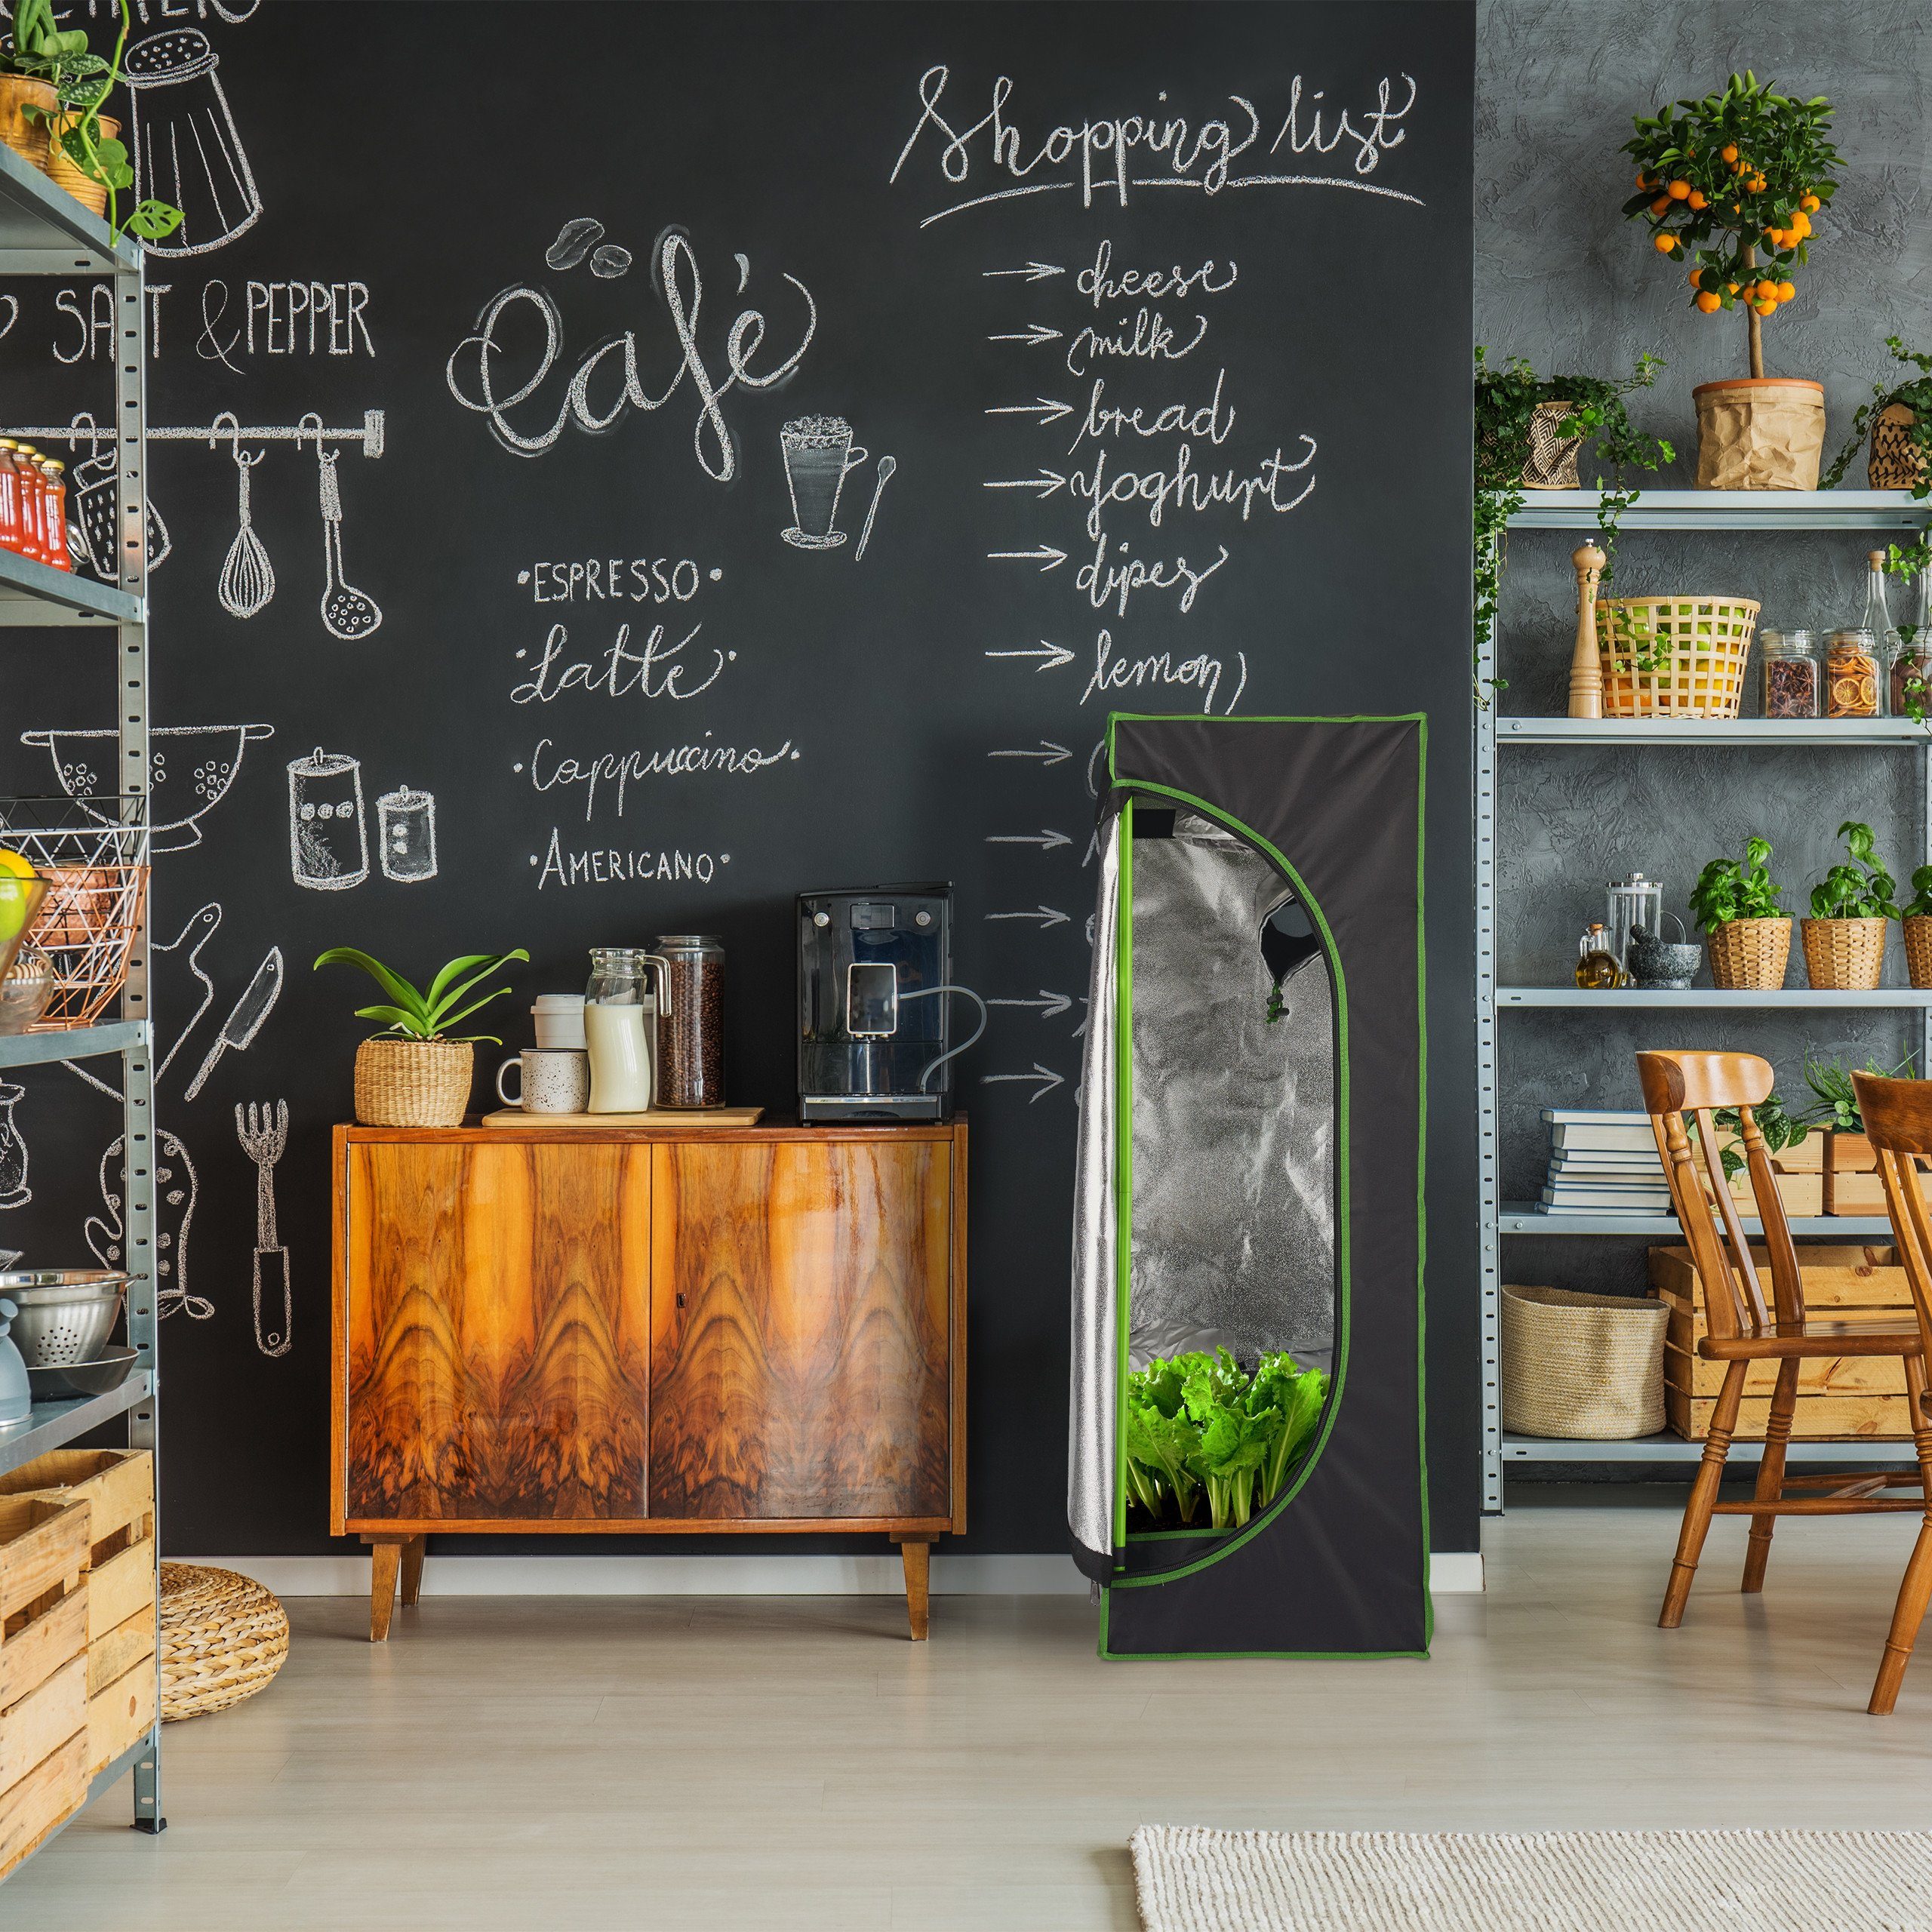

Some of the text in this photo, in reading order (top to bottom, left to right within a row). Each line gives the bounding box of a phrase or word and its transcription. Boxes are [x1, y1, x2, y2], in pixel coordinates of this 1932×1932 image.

[890, 65, 1416, 208] Shopping list
[1077, 240, 1238, 308] cheese
[53, 285, 172, 364] SAT
[196, 280, 245, 374] &
[247, 281, 375, 357] PEPPER
[1067, 307, 1208, 377] milk
[1069, 368, 1235, 455] bread
[534, 558, 699, 603] ESPRESSO
[510, 622, 724, 704] Latte
[532, 731, 792, 822] Cappuccino
